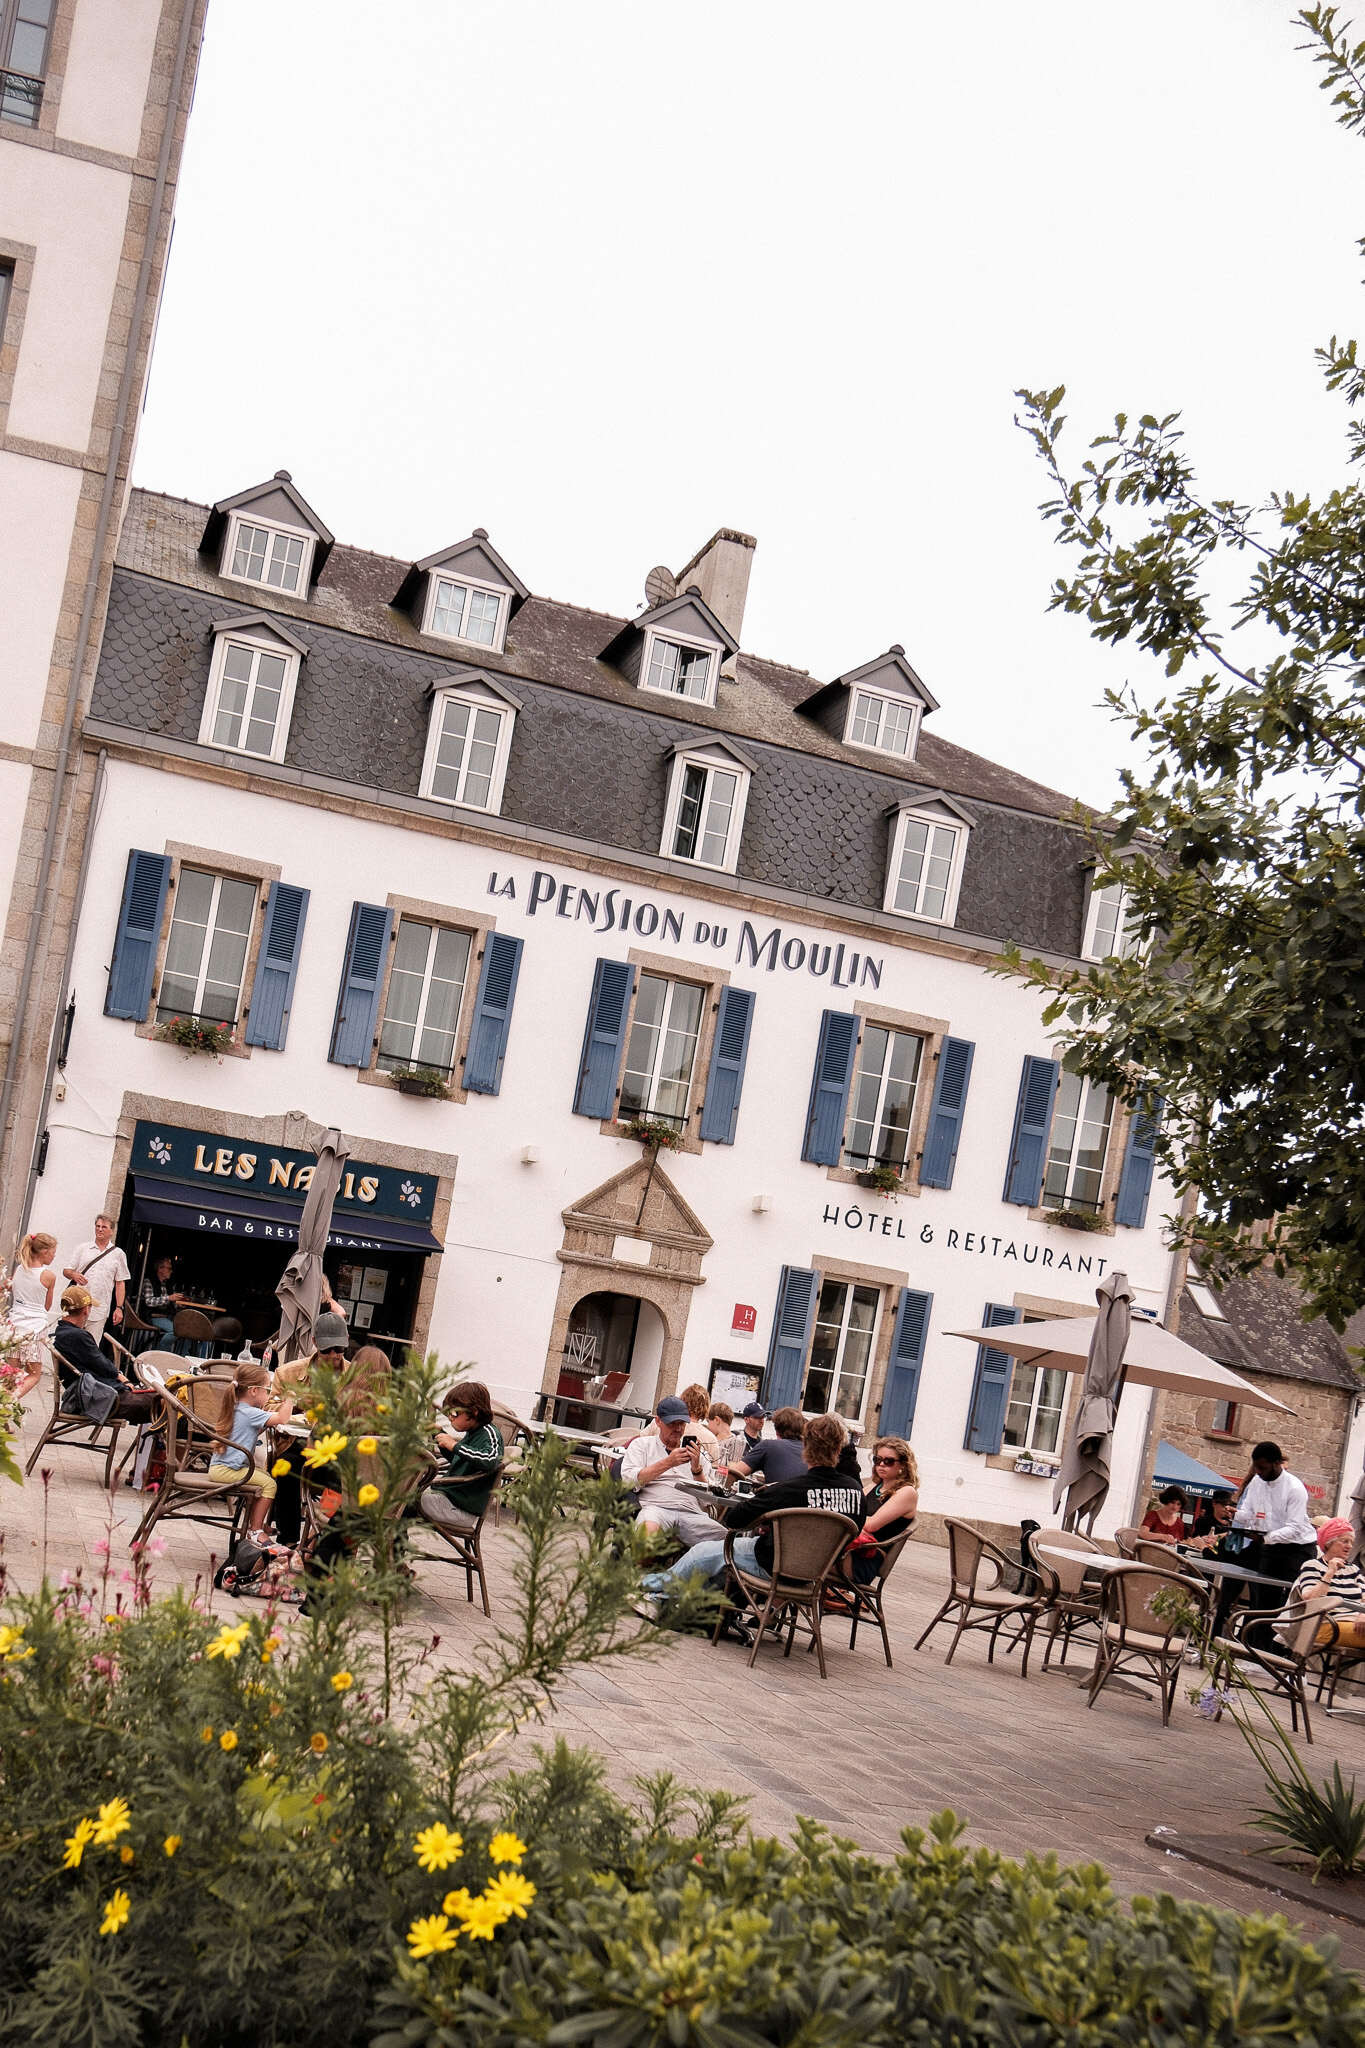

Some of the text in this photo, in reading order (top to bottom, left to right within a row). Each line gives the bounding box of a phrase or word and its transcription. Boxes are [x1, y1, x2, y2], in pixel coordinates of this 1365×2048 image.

[487, 870, 884, 990] LA PENSION DU MOULIN
[193, 1144, 379, 1203] LES NAIS
[198, 1215, 233, 1231] BAR
[244, 1222, 254, 1233] &
[822, 1204, 1109, 1277] HÔTEL & RESTAURANT
[744, 1309, 754, 1321] H
[807, 1487, 861, 1516] SECURITY
